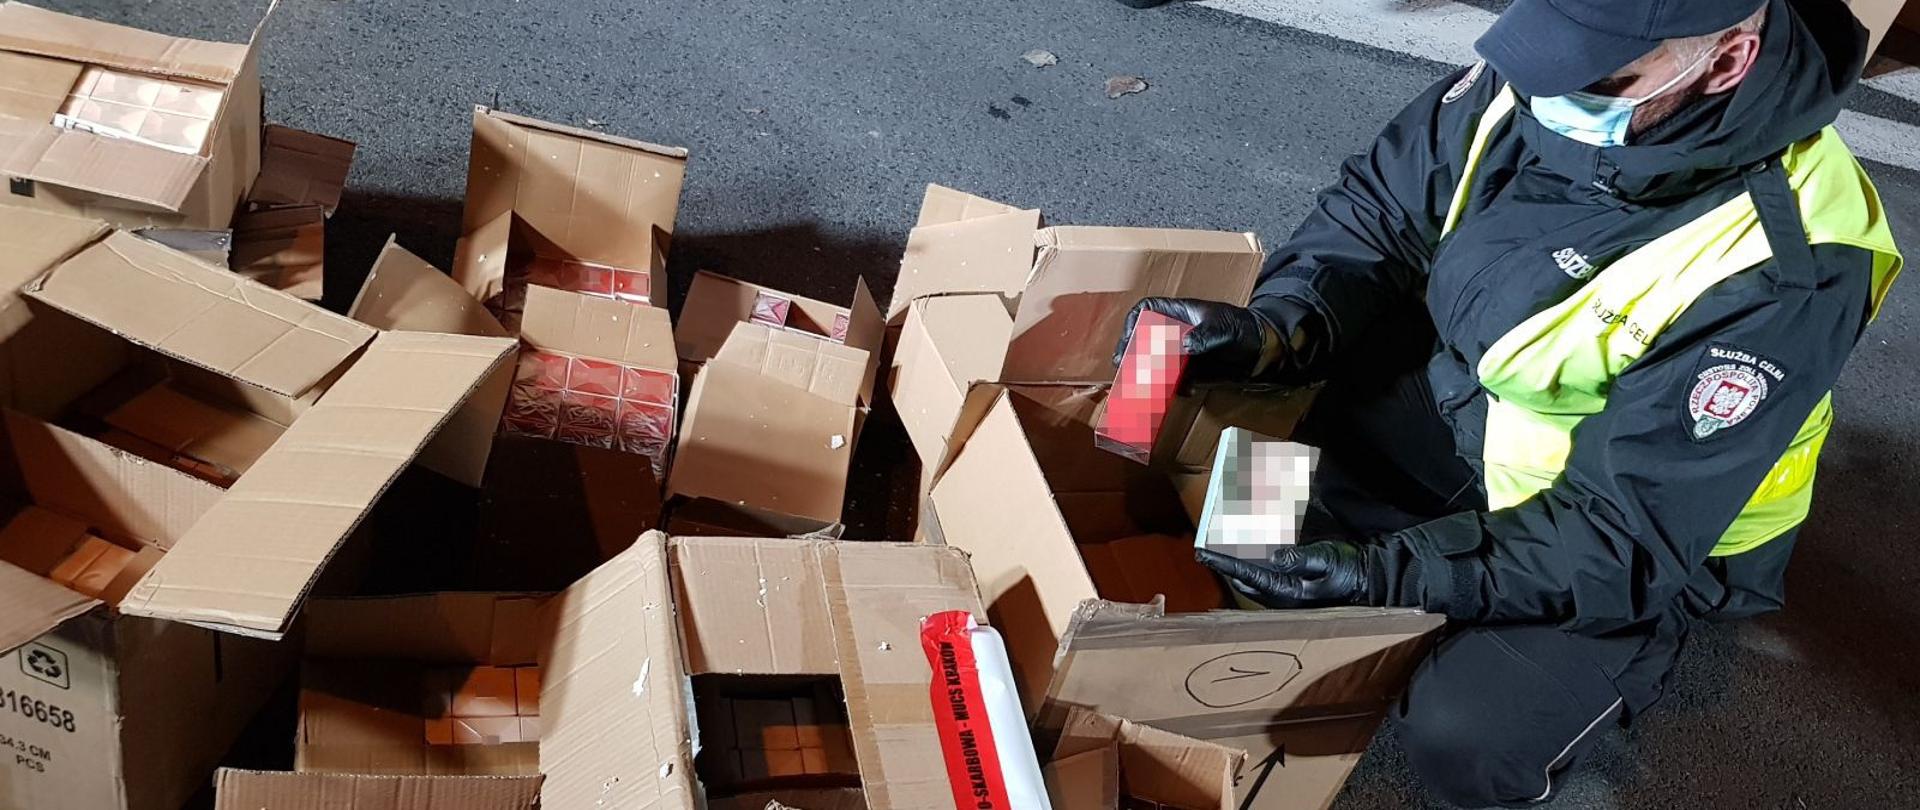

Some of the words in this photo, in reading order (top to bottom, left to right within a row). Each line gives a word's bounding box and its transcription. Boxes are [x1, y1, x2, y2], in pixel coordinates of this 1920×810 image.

[1710, 347, 1757, 366] SŁUŻBA
[948, 688, 970, 721] MUCS
[29, 744, 52, 762] CM
[16, 754, 45, 773] PCS
